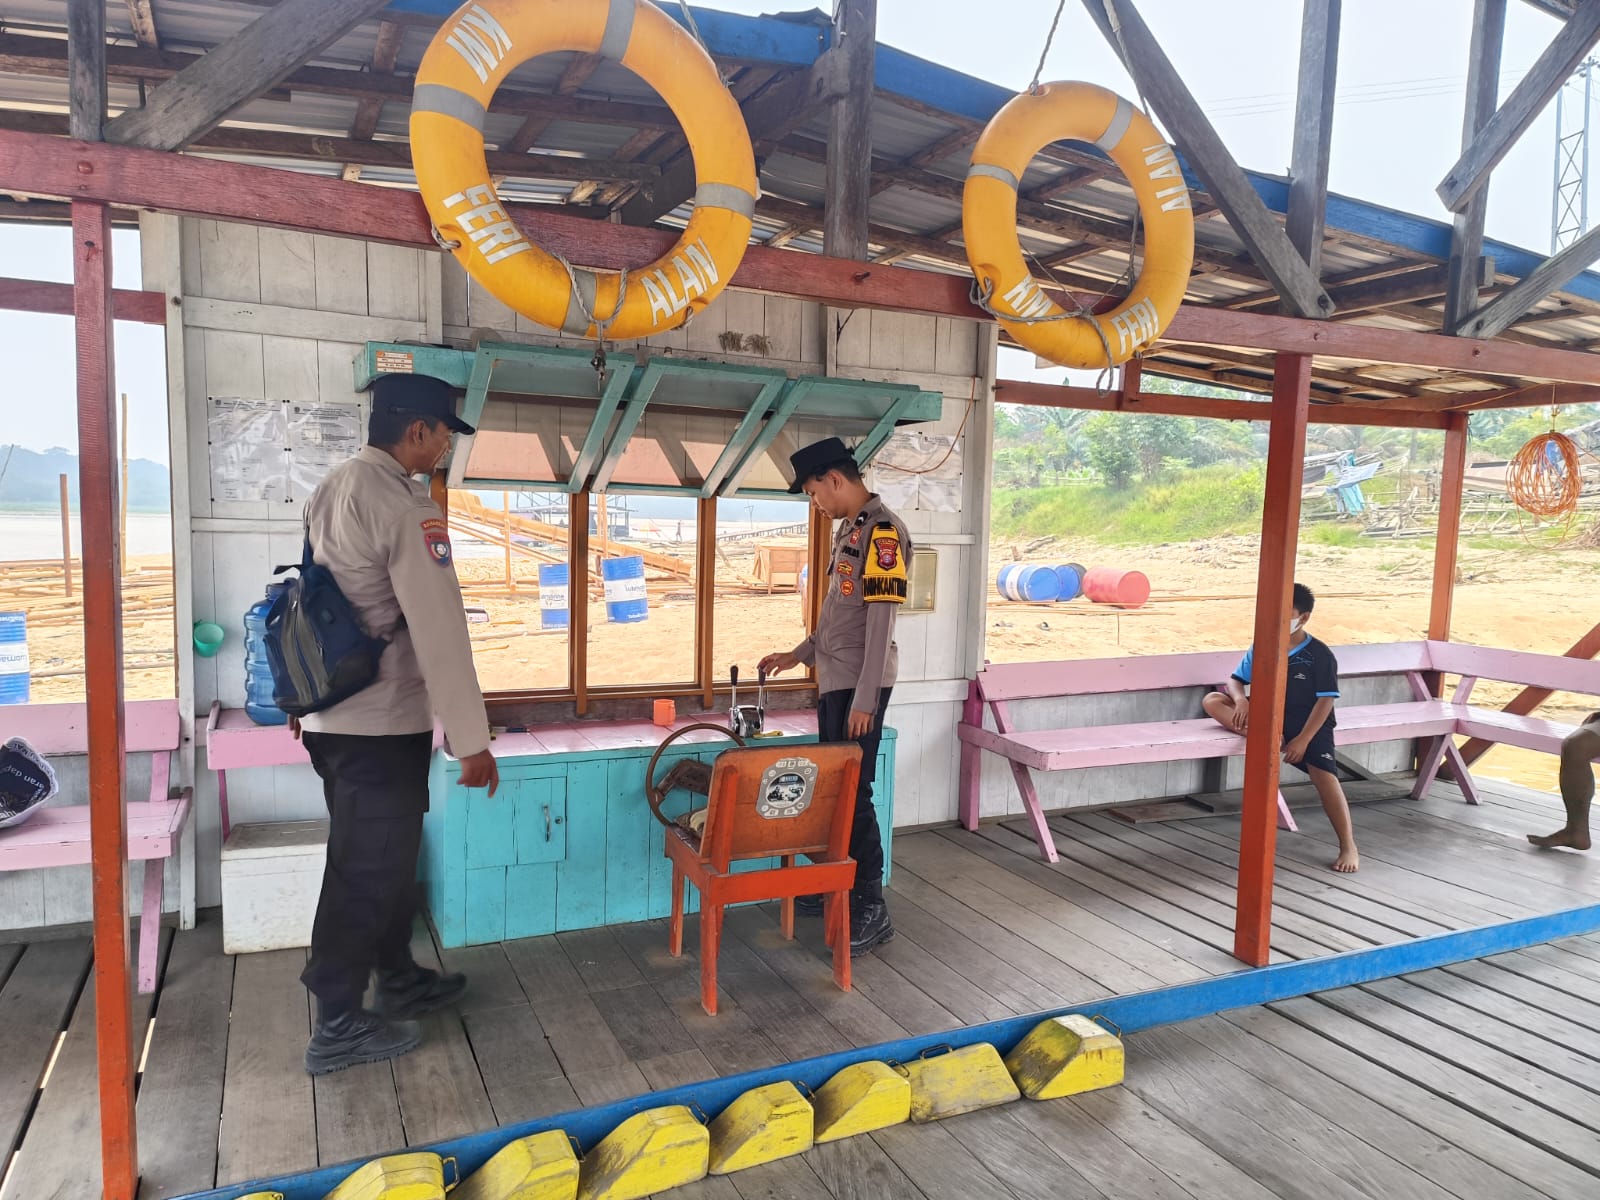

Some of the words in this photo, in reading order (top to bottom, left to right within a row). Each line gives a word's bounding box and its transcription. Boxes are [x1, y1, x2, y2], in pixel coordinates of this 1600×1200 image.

[446, 4, 512, 85] KM
[640, 237, 719, 326] ALAN
[1002, 273, 1053, 326] KM
[1111, 297, 1160, 355] FERI
